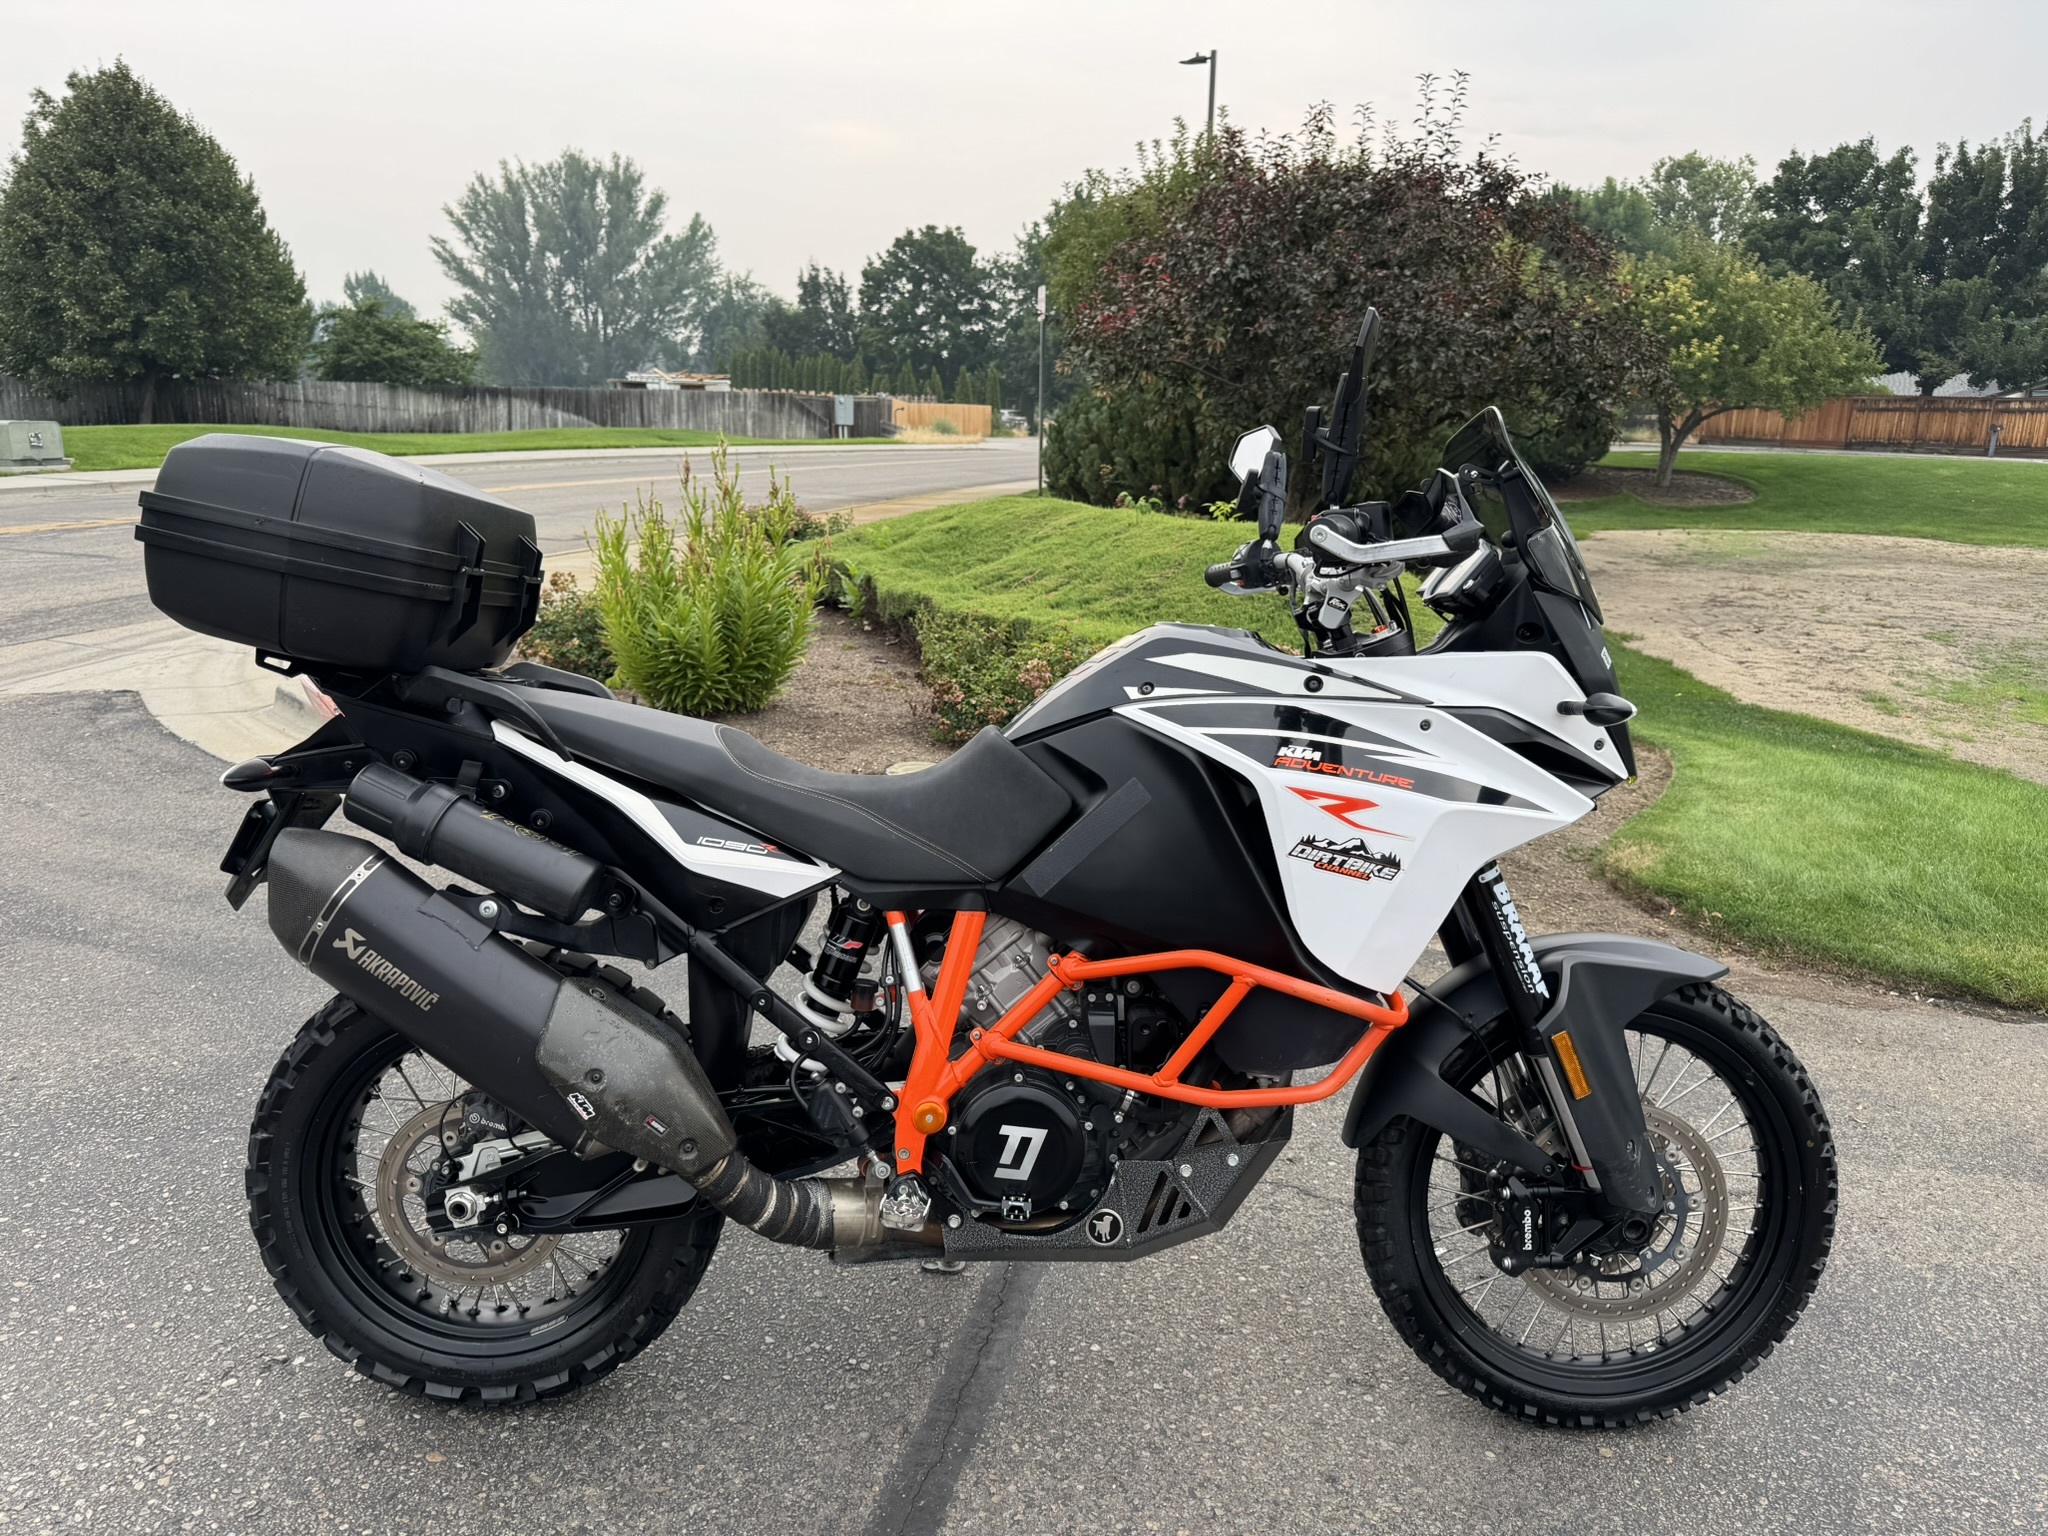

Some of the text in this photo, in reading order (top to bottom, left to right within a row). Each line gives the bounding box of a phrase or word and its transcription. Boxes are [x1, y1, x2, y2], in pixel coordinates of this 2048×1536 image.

[1277, 745, 1322, 761] KTM
[1273, 756, 1415, 790] ADVENTURE
[1315, 861, 1371, 880] CHANNEL
[569, 1092, 596, 1118] KTM
[1522, 1209, 1533, 1251] brembo
